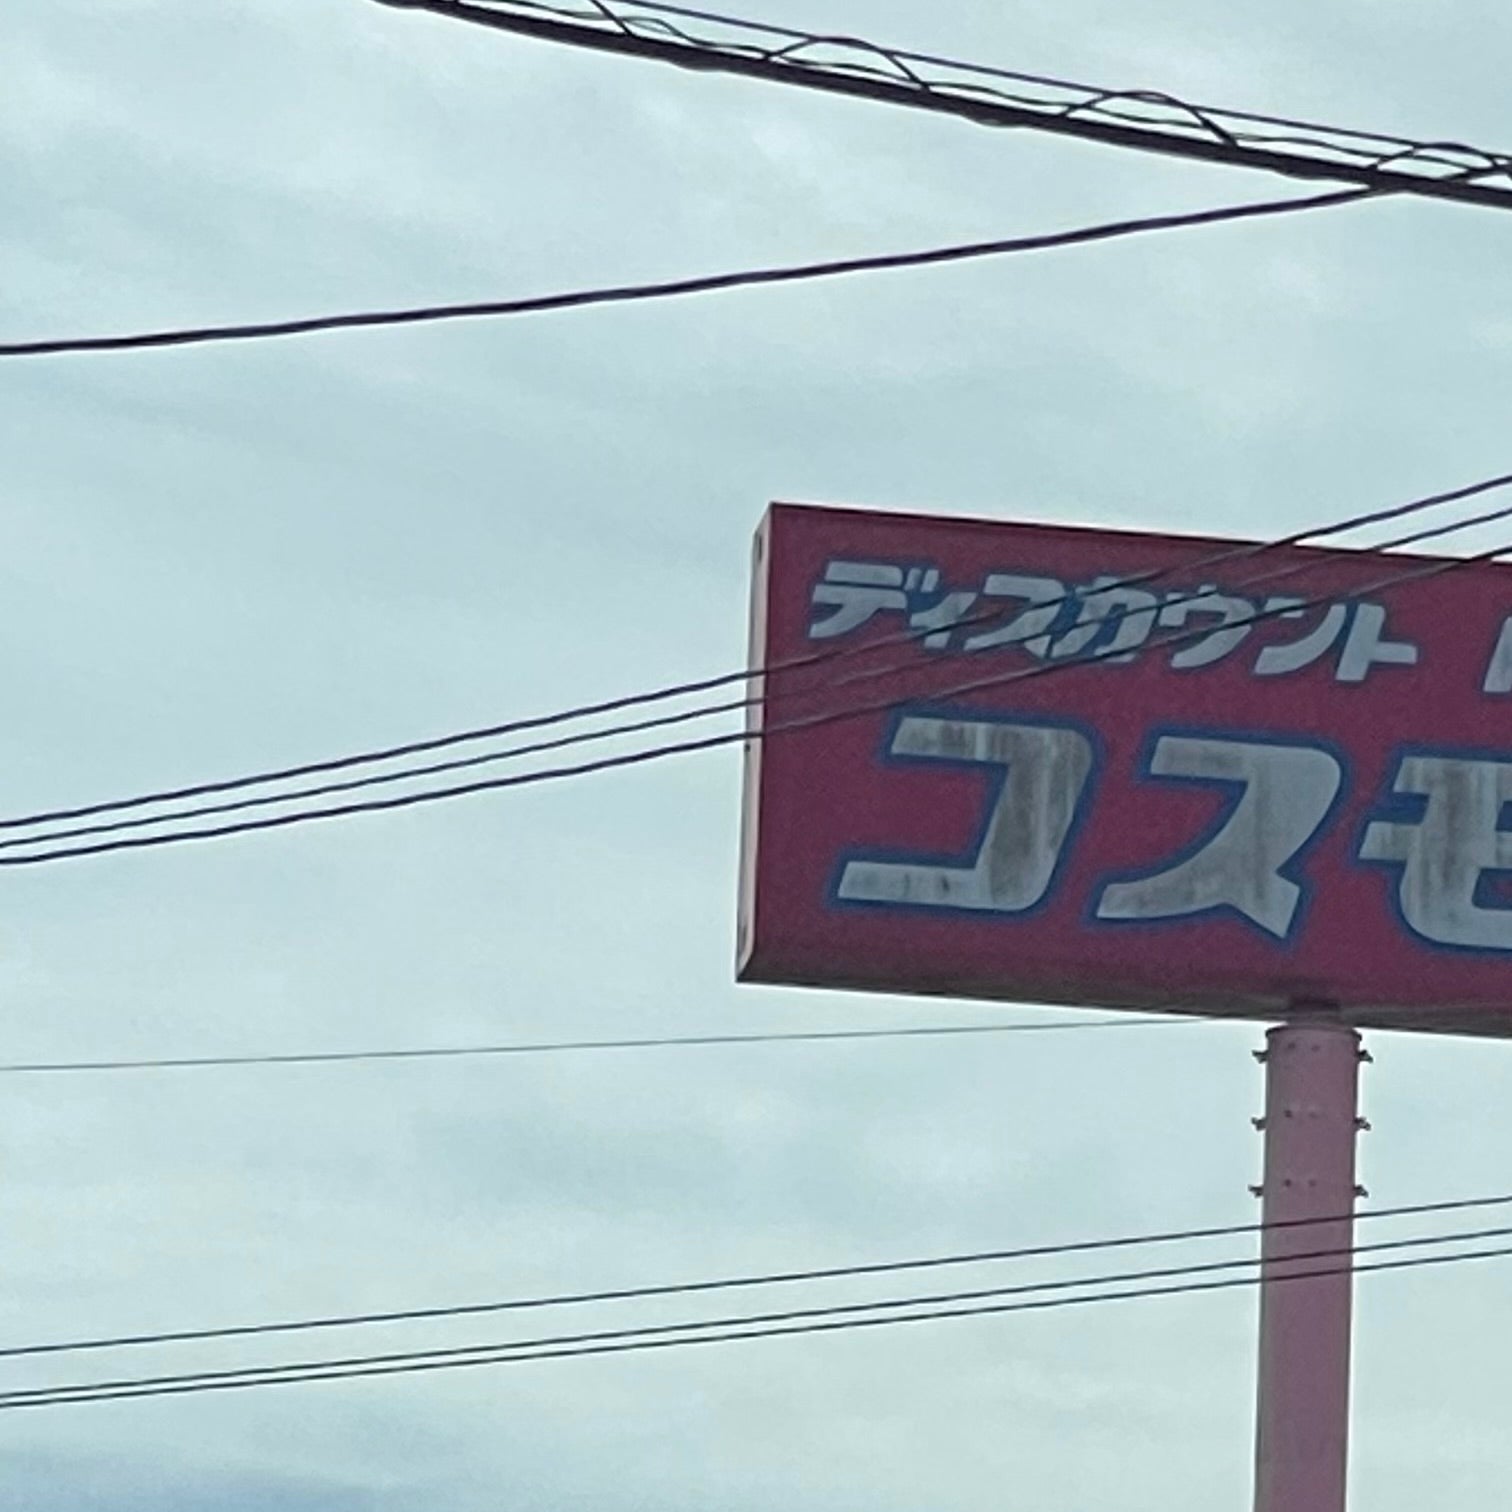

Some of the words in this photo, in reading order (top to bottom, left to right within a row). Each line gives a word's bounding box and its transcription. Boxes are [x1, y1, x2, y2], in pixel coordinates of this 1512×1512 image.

[808, 560, 1419, 683] ディスカウント
